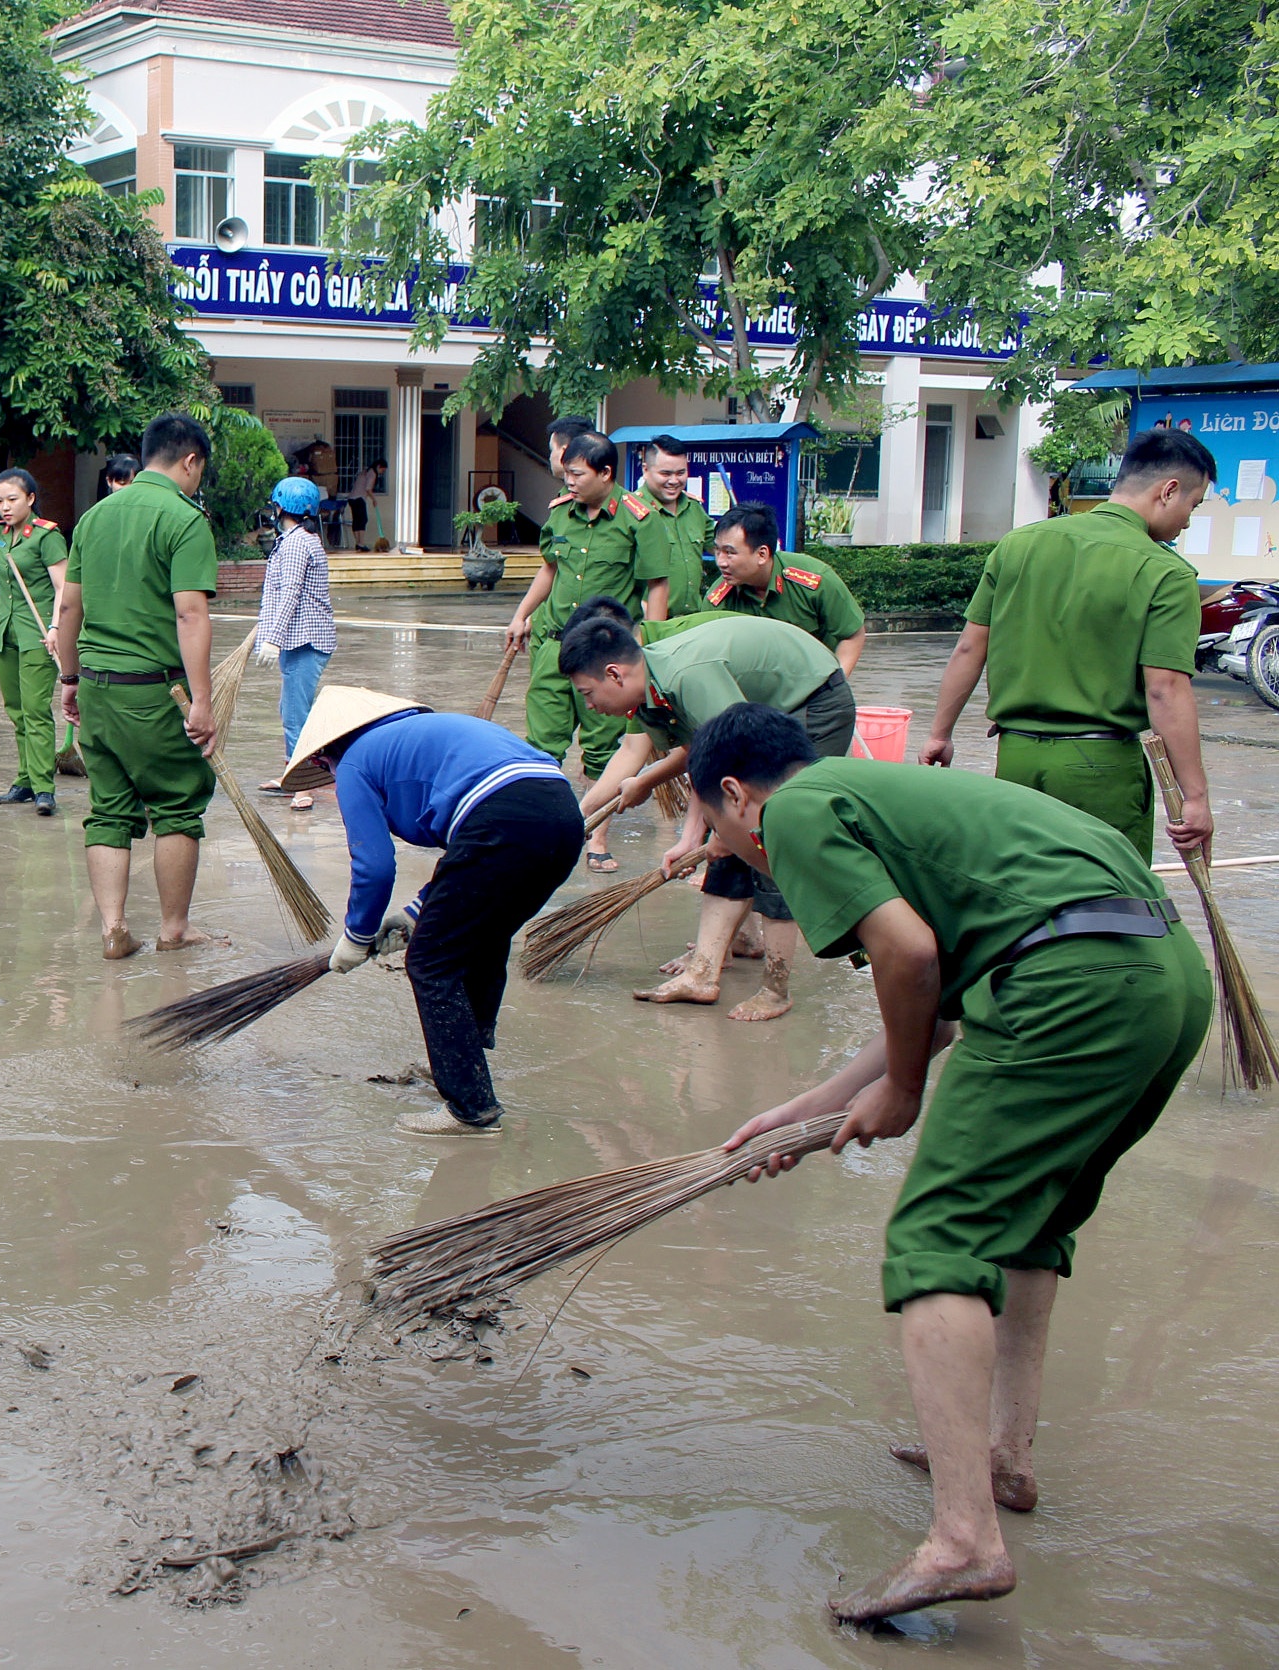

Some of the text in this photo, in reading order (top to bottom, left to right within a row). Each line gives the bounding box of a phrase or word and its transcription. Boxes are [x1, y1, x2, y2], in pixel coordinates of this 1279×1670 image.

[226, 259, 285, 305] THẦY
[290, 266, 321, 307] CÔ
[893, 306, 926, 345] ĐẾN
[1200, 412, 1246, 432] Liên
[693, 452, 709, 465] PHỤ
[710, 452, 736, 464] HUYNH
